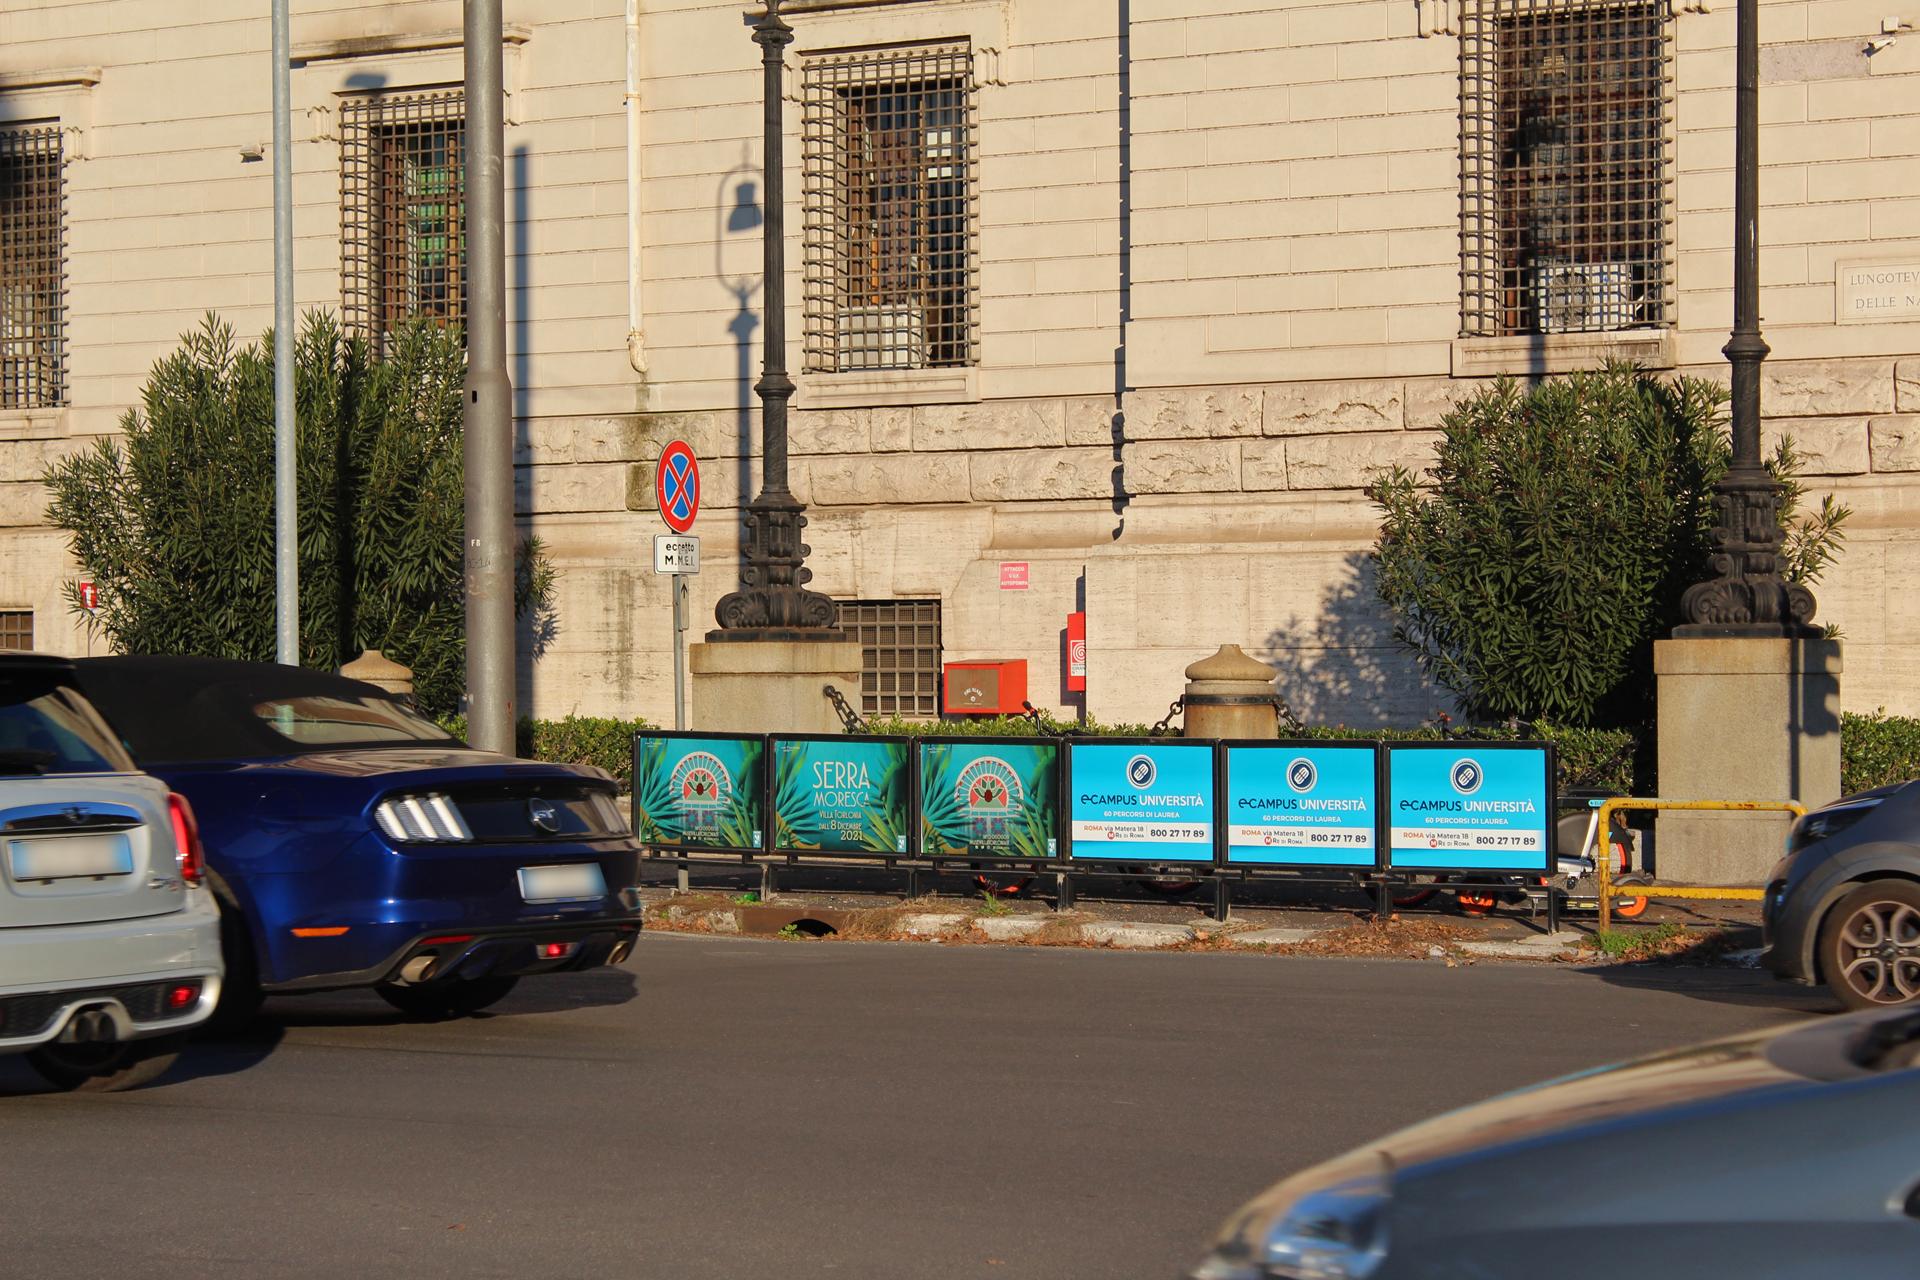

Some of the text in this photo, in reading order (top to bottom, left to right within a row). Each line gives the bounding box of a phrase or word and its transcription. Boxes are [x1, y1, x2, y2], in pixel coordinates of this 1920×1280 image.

[1856, 296, 1896, 309] DELLE
[666, 542, 694, 552] eccetto
[812, 761, 870, 789] SERRA
[814, 792, 870, 808] MORESCA
[1140, 793, 1204, 806] UNIVERSITÀ
[1300, 798, 1366, 811] UNIVERSITÀ
[1464, 800, 1535, 812] UNIVERSITÀ
[840, 830, 864, 840] 2021
